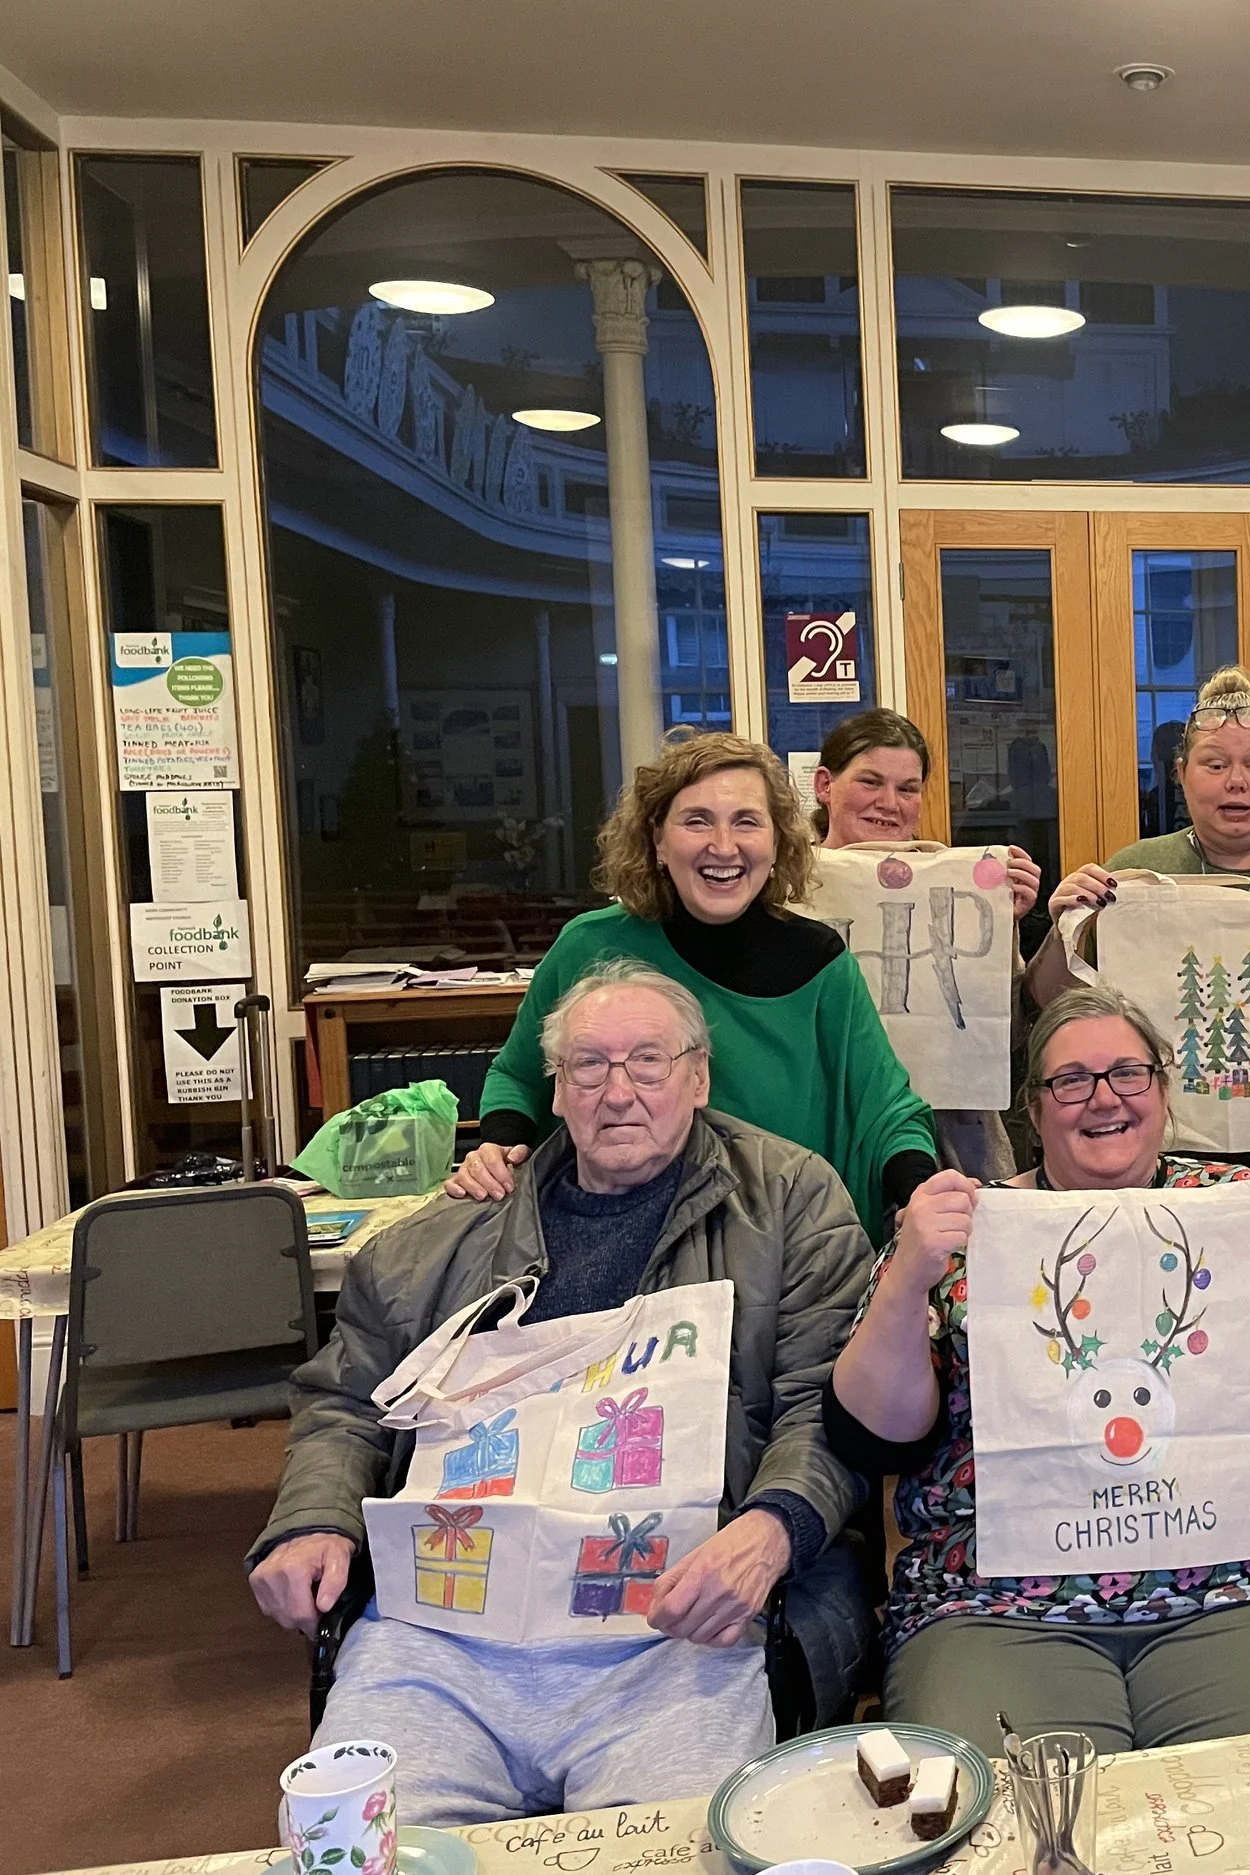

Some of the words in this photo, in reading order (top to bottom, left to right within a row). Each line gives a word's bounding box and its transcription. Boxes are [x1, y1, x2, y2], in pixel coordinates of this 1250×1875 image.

[120, 645, 169, 655] foodbank
[839, 662, 851, 677] T
[123, 740, 158, 748] TINNED
[153, 805, 199, 814] foodbank
[169, 927, 239, 941] foodbank
[147, 944, 214, 955] COLLECTION
[149, 961, 182, 971] POINT
[551, 1320, 698, 1394] HUA
[1093, 1477, 1176, 1510] MERRY
[1055, 1500, 1217, 1552] CHRISTMAS
[577, 1828, 605, 1842] au
[616, 1810, 671, 1838] lait
[1148, 1852, 1173, 1875] lait
